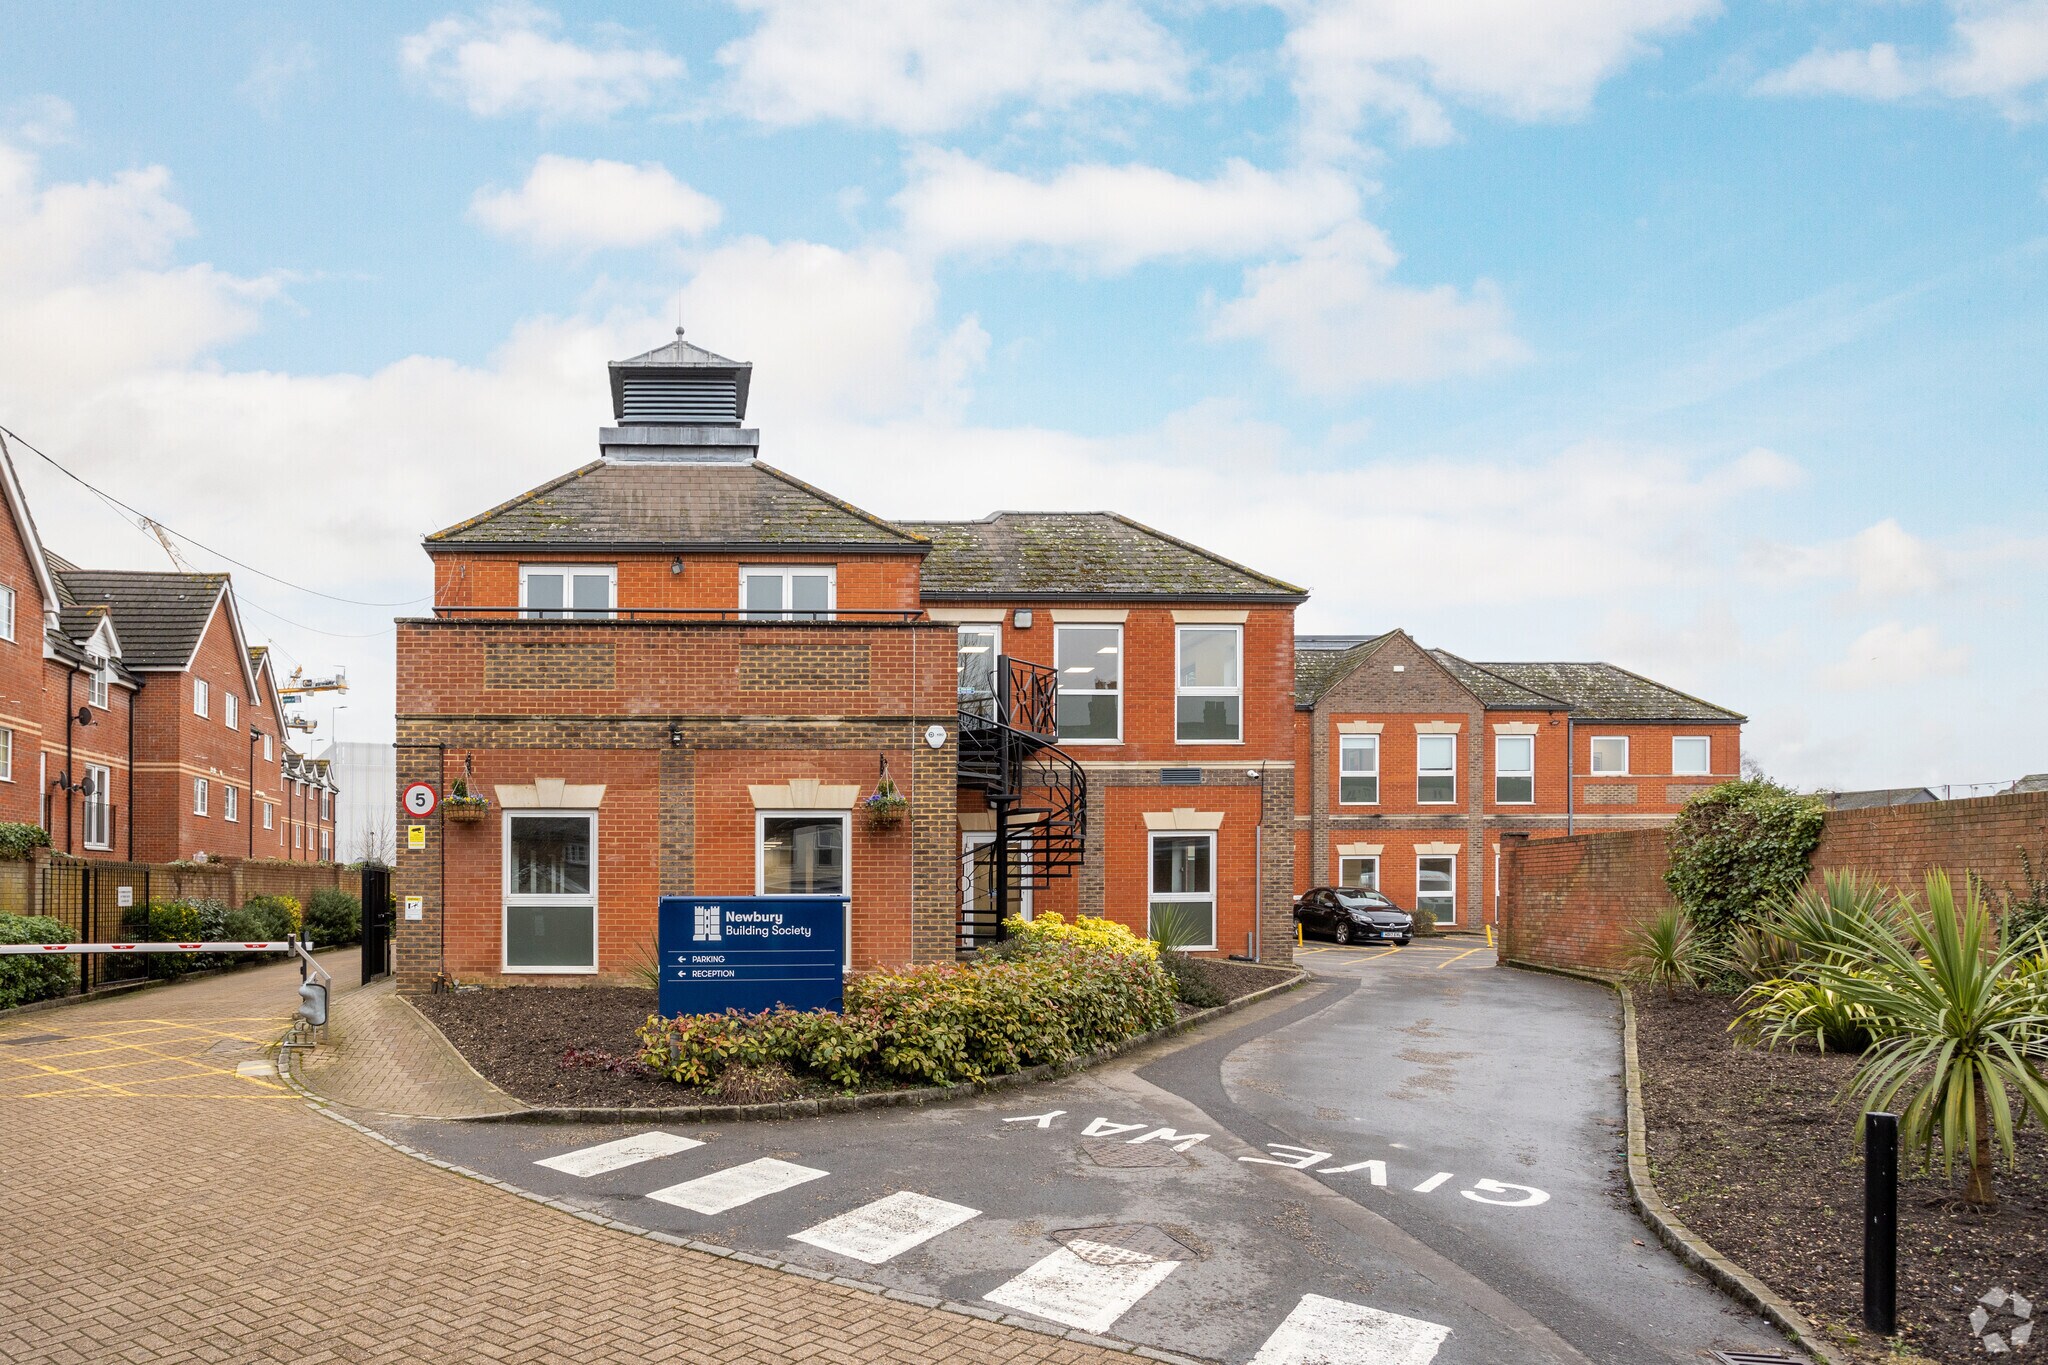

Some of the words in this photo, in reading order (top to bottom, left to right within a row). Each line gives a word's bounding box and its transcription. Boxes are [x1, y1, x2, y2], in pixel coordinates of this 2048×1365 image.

[415, 793, 426, 807] 5
[725, 911, 783, 925] Newbury
[725, 925, 769, 938] Building
[771, 925, 812, 938] Society
[692, 955, 726, 963] PARKING
[692, 969, 735, 978] RECEPTION
[1002, 1110, 1210, 1152] WAY
[1238, 1143, 1551, 1207] GIVE
